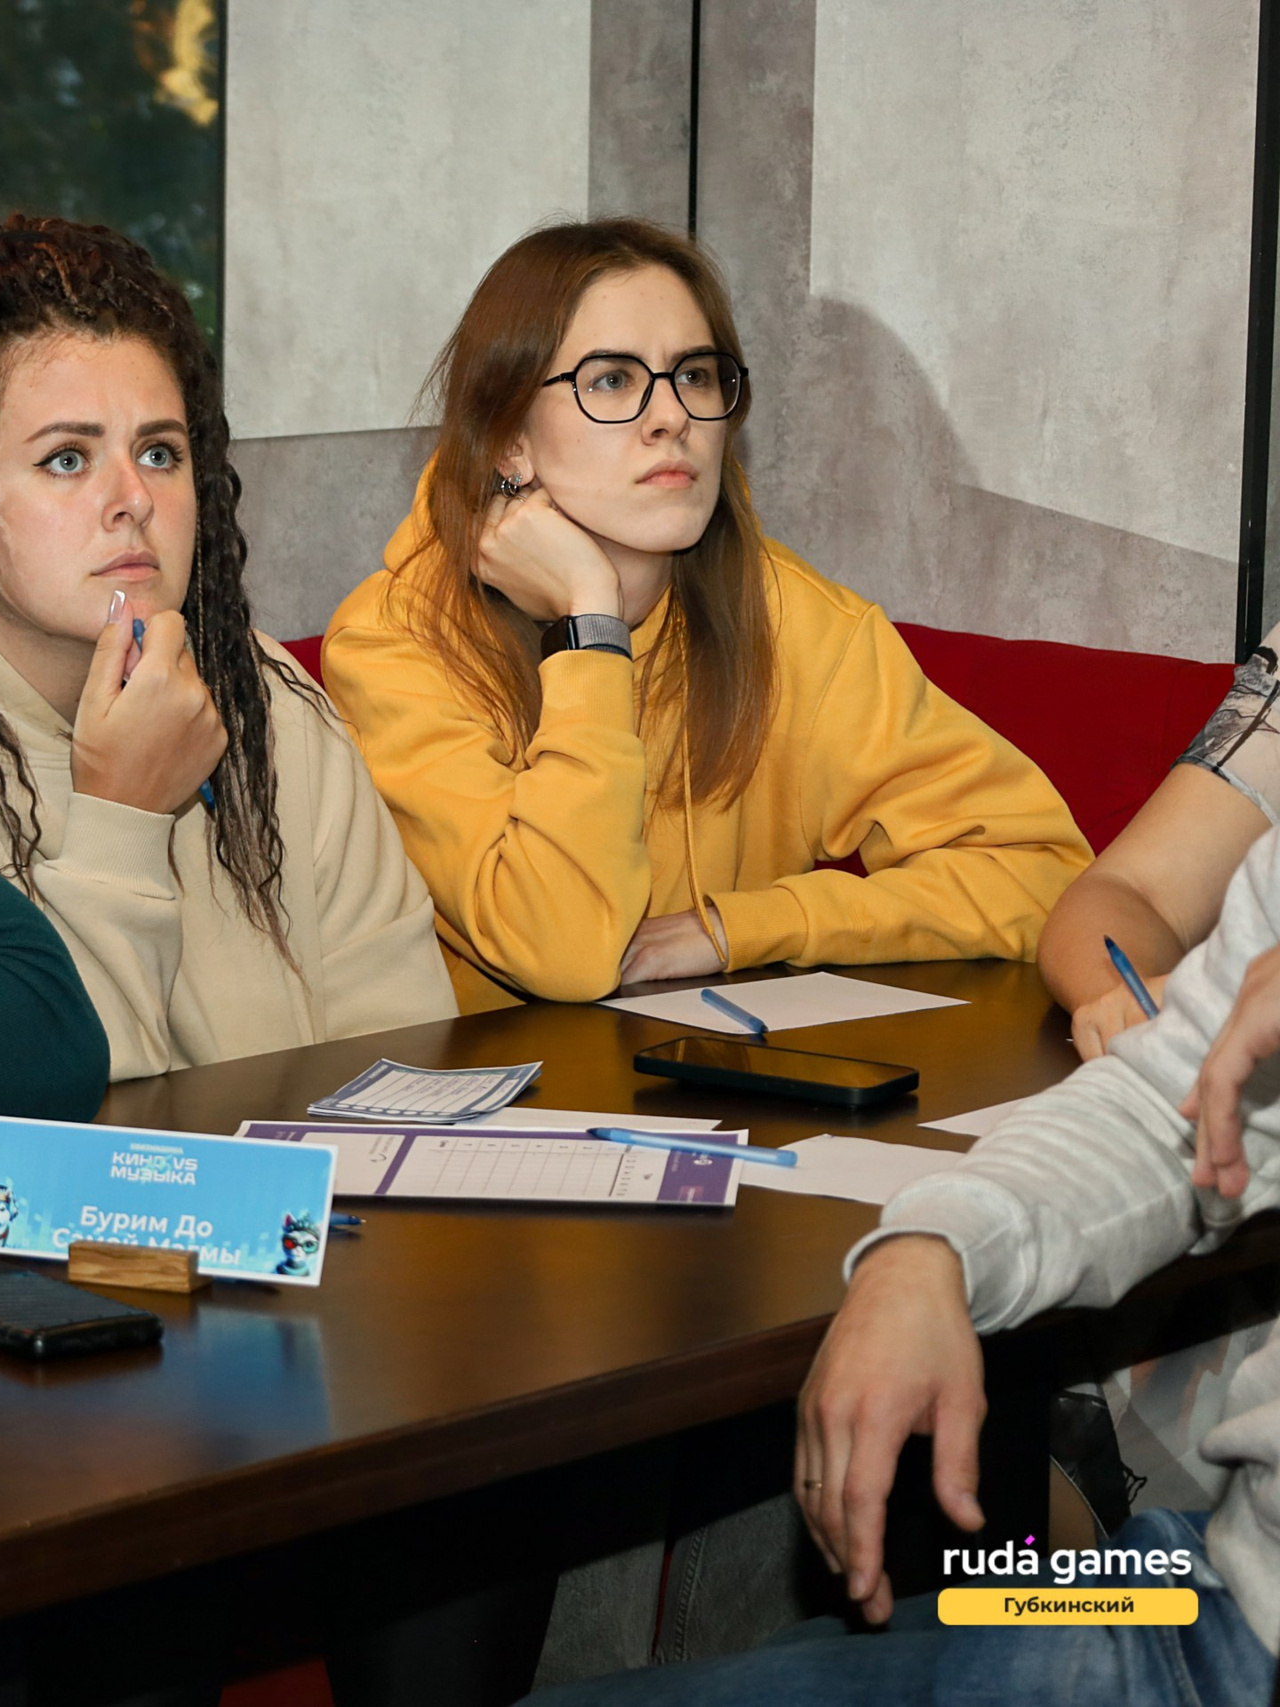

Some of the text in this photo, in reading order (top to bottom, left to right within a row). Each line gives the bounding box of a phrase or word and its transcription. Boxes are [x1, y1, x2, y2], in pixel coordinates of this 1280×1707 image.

[112, 1151, 199, 1172] КИНО VS
[110, 1165, 197, 1186] МУЗЫКА
[80, 1205, 214, 1239] Бурим До
